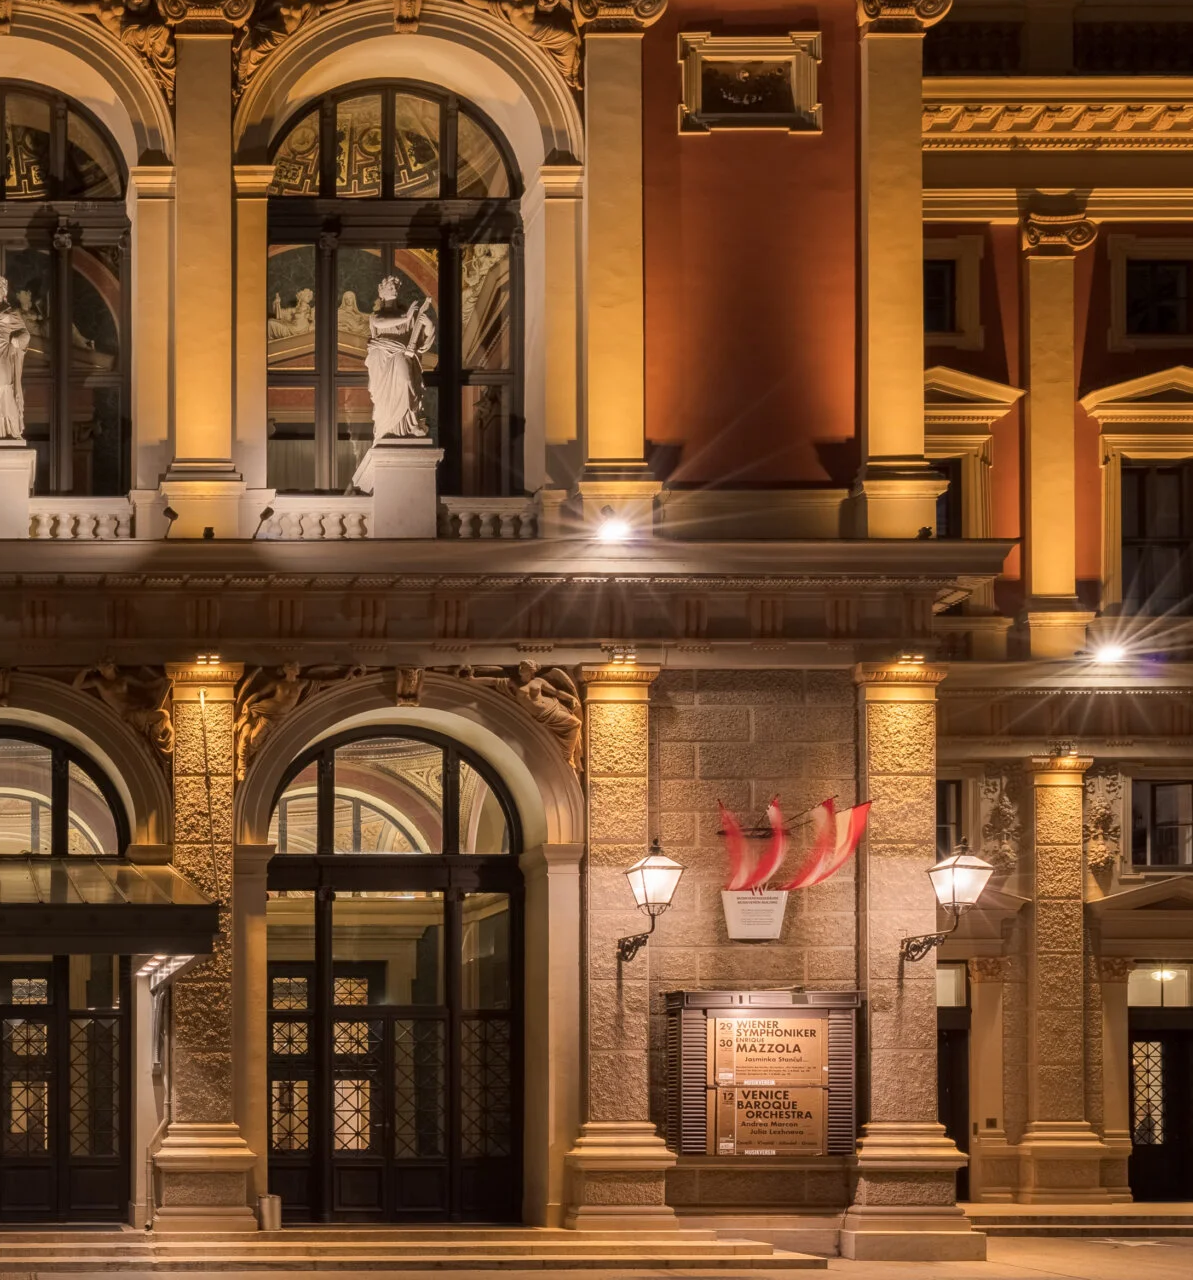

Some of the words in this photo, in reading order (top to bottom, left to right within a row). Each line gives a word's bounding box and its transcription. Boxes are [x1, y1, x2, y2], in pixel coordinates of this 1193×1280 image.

[719, 1022, 733, 1030] 29
[736, 1020, 779, 1029] WIENER
[736, 1028, 817, 1038] SYMPHONIKER
[719, 1039, 733, 1047] 30
[736, 1044, 802, 1053] MAZZOLA
[722, 1092, 734, 1100] 12
[741, 1090, 789, 1100] VENICE
[737, 1101, 798, 1110] BAROQUE
[746, 1110, 813, 1119] ORCHESTRA
